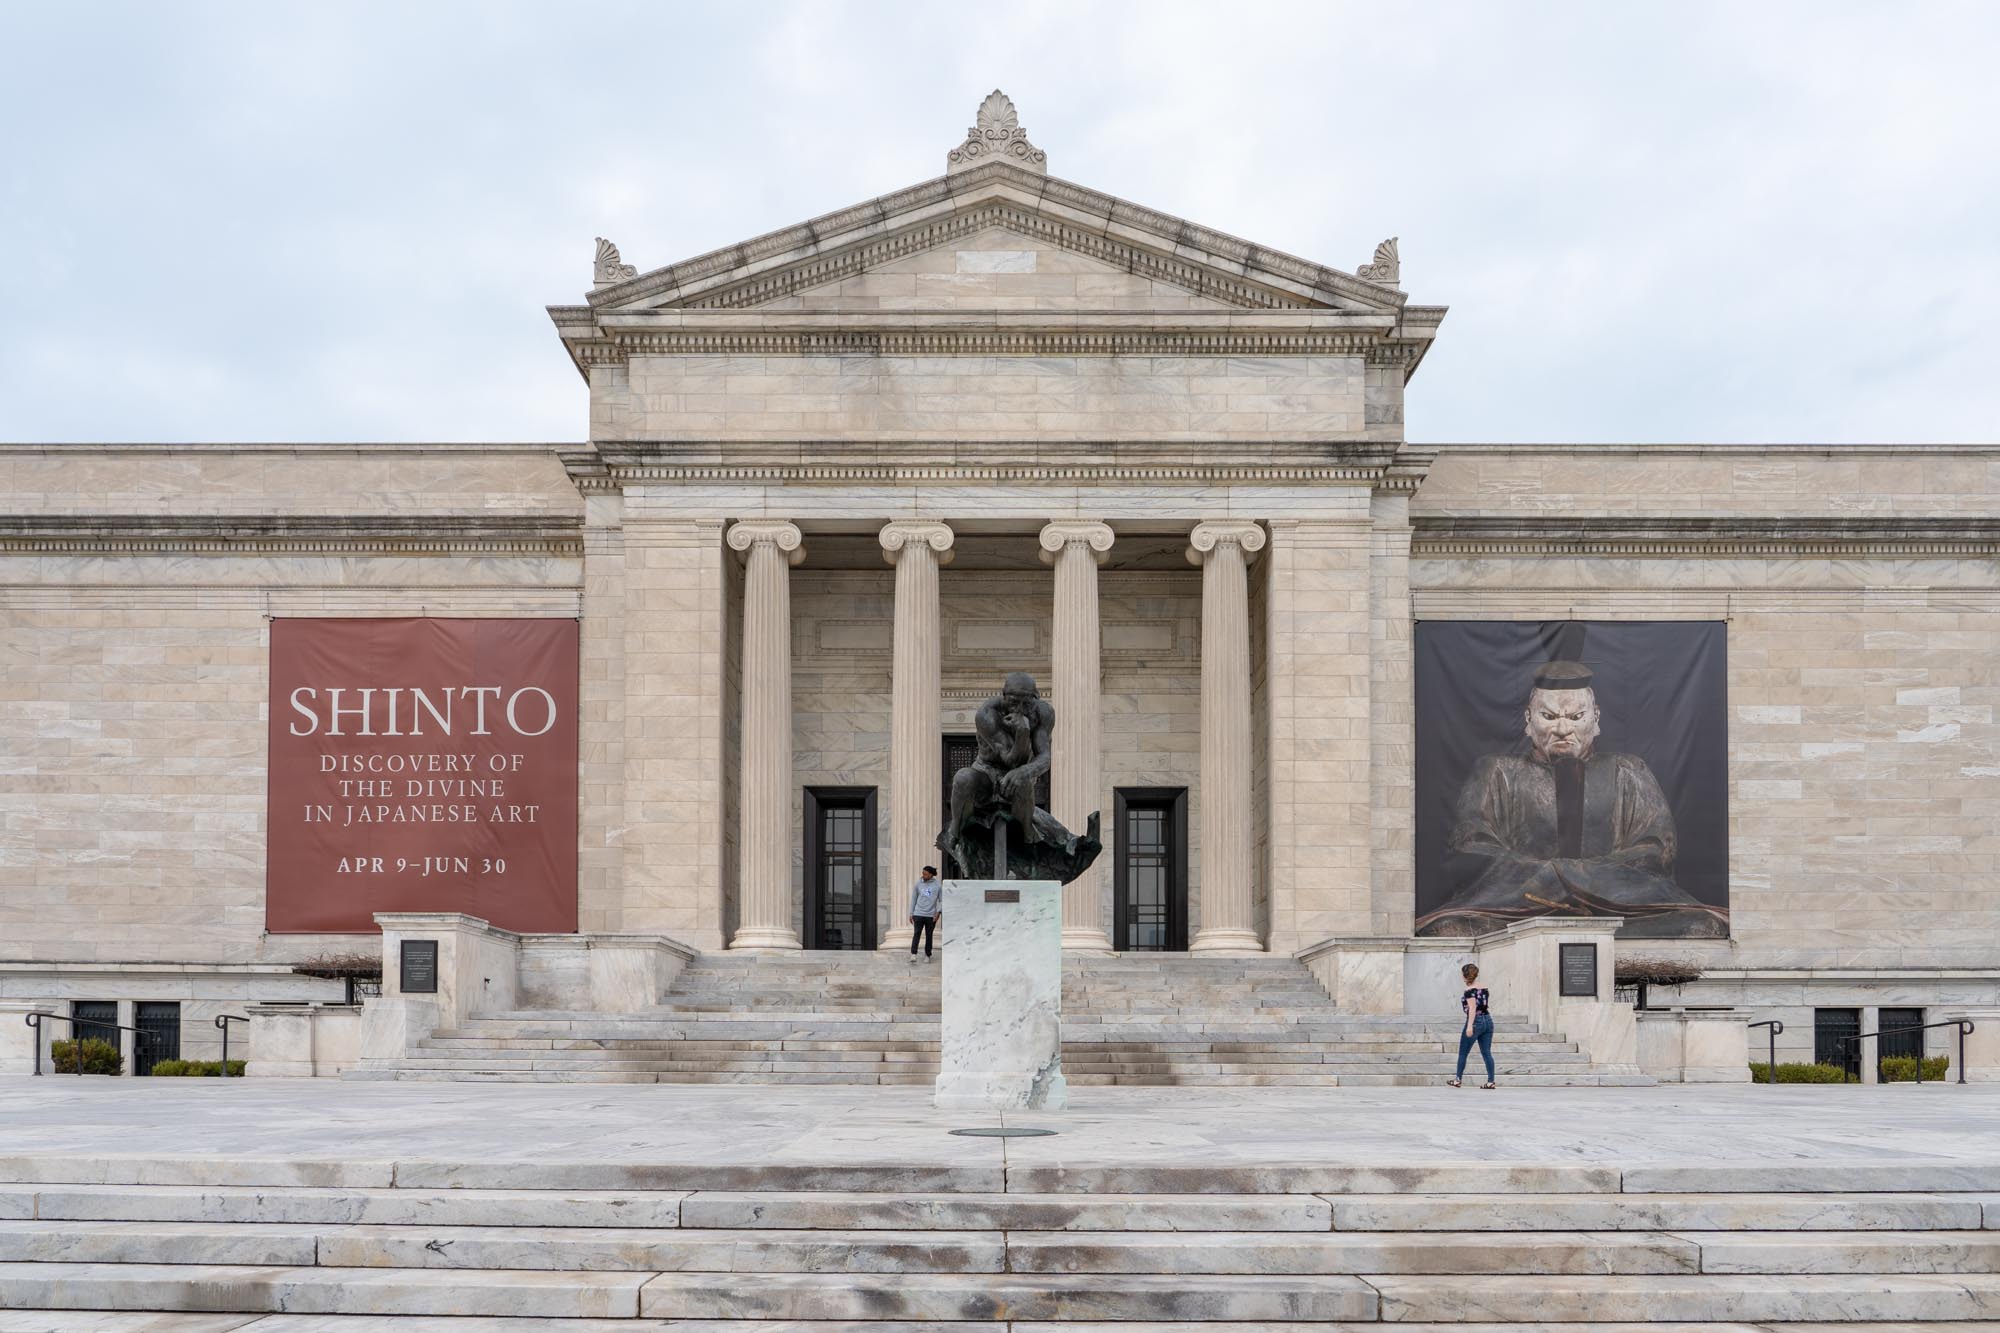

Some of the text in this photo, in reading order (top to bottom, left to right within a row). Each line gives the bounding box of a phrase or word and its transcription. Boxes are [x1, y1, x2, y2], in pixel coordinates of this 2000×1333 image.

[290, 686, 556, 736] SHINTO
[320, 754, 523, 772] DISCOVERY OF
[339, 780, 504, 797] THE DIVINE
[304, 805, 539, 826] IN JAPANESE ART
[337, 857, 384, 873] APR
[482, 858, 505, 873] 30
